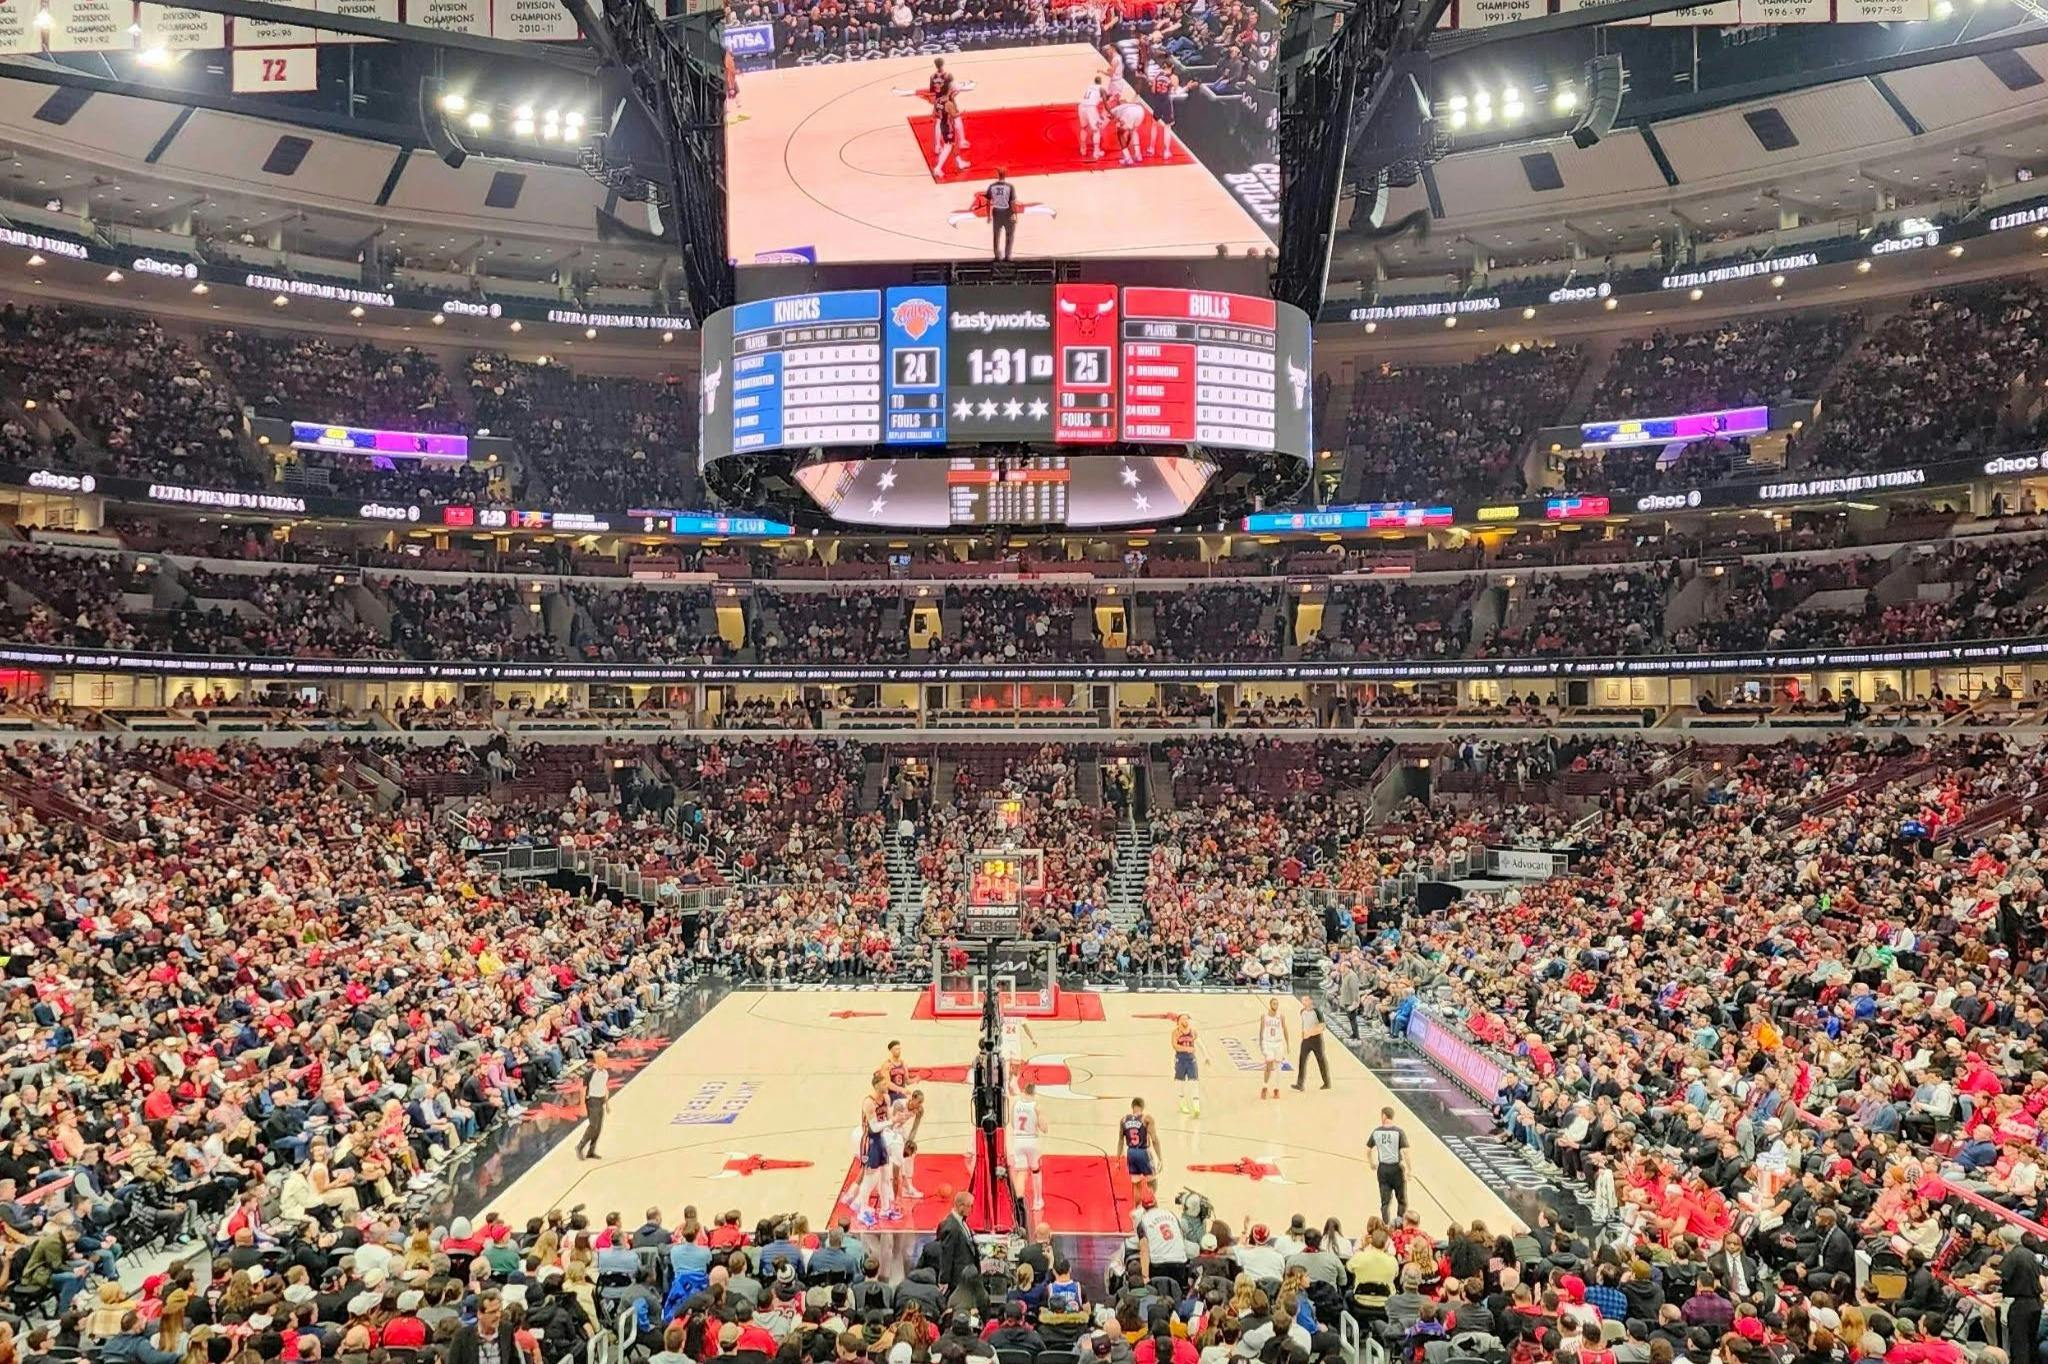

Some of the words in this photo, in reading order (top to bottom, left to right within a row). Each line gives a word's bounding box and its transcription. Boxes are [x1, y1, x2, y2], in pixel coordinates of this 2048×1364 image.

[337, 4, 376, 14] DIVISION
[429, 3, 468, 12] DIVISION
[516, 1, 556, 10] DIVISION
[1476, 1, 1530, 10] CHAMPIONS
[423, 14, 475, 24] CHAMPIONS
[510, 13, 562, 22] CHAMPIONS
[262, 58, 288, 82] 72
[1990, 209, 2036, 231] ULTRA
[44, 234, 88, 260] VODKA
[1662, 271, 1706, 289] ULTRA
[1707, 260, 1770, 285] PREMIUM
[1771, 253, 1818, 273] VODKA
[246, 273, 290, 293] ULTRA
[290, 280, 351, 302] PREMIUM
[350, 288, 394, 308] VODKA
[774, 296, 820, 324] KNICKS
[1189, 294, 1230, 320] BULLS
[1350, 306, 1394, 320] ULTRA
[1394, 302, 1456, 319] PREMIUM
[1457, 298, 1500, 314] VODKA
[548, 310, 588, 326] ULTRA
[588, 313, 648, 329] PREMIUM
[650, 315, 692, 330] VODKA
[950, 310, 1050, 334] tastyworks.
[1144, 324, 1178, 338] PLAYERS
[904, 353, 927, 382] 24
[968, 348, 1027, 384] 1:31
[1074, 352, 1099, 382] 25
[891, 394, 904, 410] TO
[1062, 392, 1075, 408] TO
[891, 414, 920, 428] FOULS
[1062, 412, 1092, 427] FOULS
[1760, 482, 1808, 500] ULTRA
[1809, 474, 1878, 496] PREMIUM
[1878, 470, 1926, 488] VODKA
[148, 484, 192, 503] ULTRA
[192, 488, 258, 508] PREMIUM
[258, 496, 306, 512] VODKA
[736, 520, 766, 532] CLUB
[1310, 514, 1342, 526] CLUB
[1512, 859, 1548, 870] Advocate
[983, 906, 1018, 916] TISSOT
[1018, 1116, 1028, 1131] 7
[1160, 1224, 1174, 1242] 6
